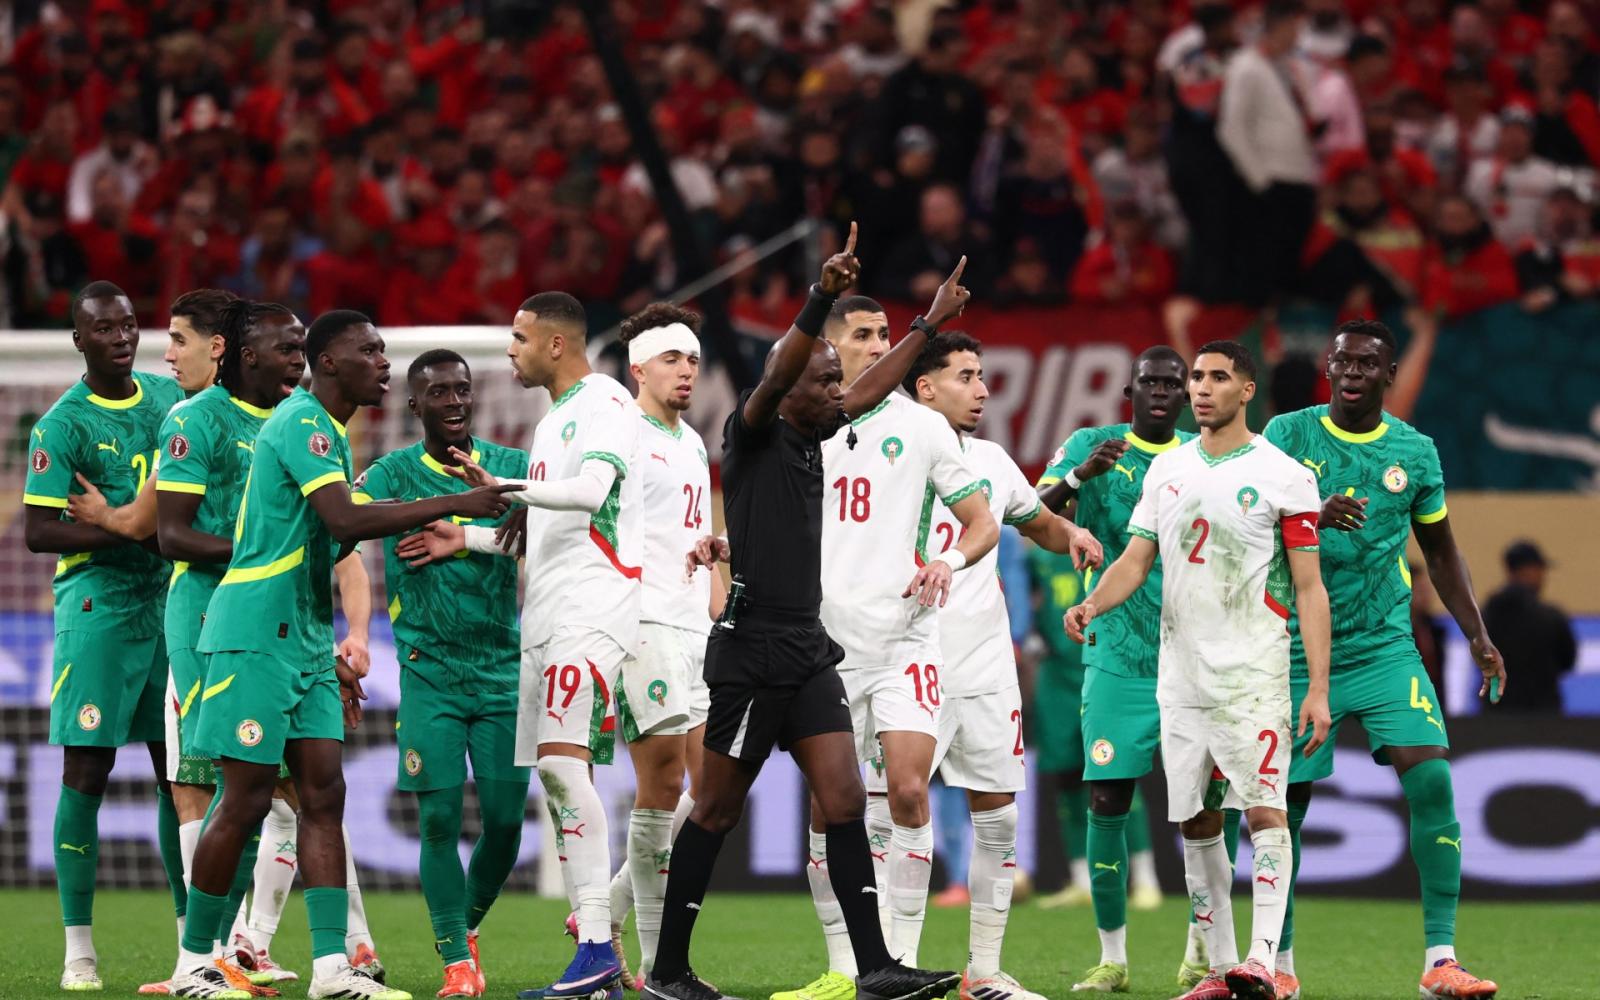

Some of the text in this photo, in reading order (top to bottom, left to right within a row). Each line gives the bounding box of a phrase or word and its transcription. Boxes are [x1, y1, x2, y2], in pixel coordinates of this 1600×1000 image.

[683, 483, 702, 530] 24
[833, 476, 871, 523] 18
[1188, 517, 1210, 565] 2
[543, 664, 581, 709] 19
[904, 662, 940, 706] 18
[1410, 676, 1433, 713] 4
[1258, 729, 1279, 775] 2
